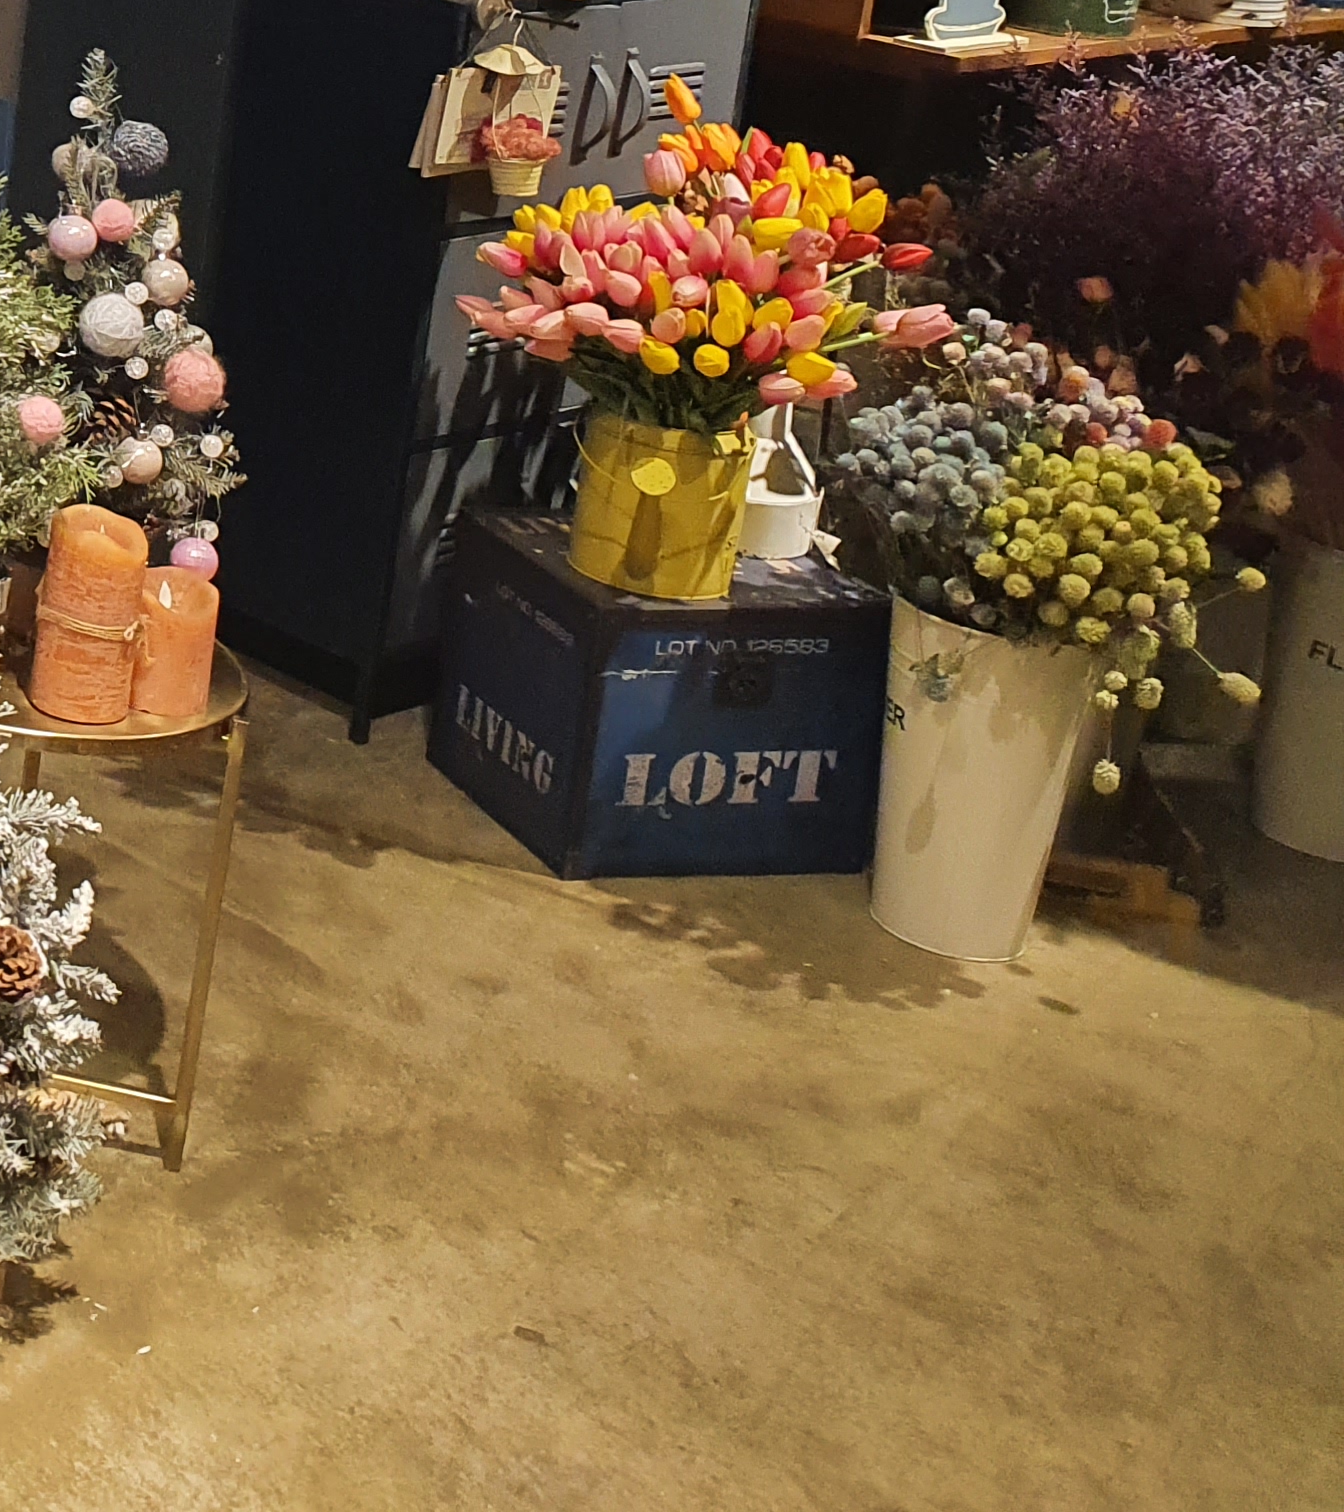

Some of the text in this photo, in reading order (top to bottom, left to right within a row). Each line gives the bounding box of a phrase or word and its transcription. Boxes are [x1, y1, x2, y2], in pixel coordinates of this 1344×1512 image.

[655, 639, 700, 656] LOT
[456, 683, 556, 795] LIVING
[614, 749, 838, 807] LOFT
